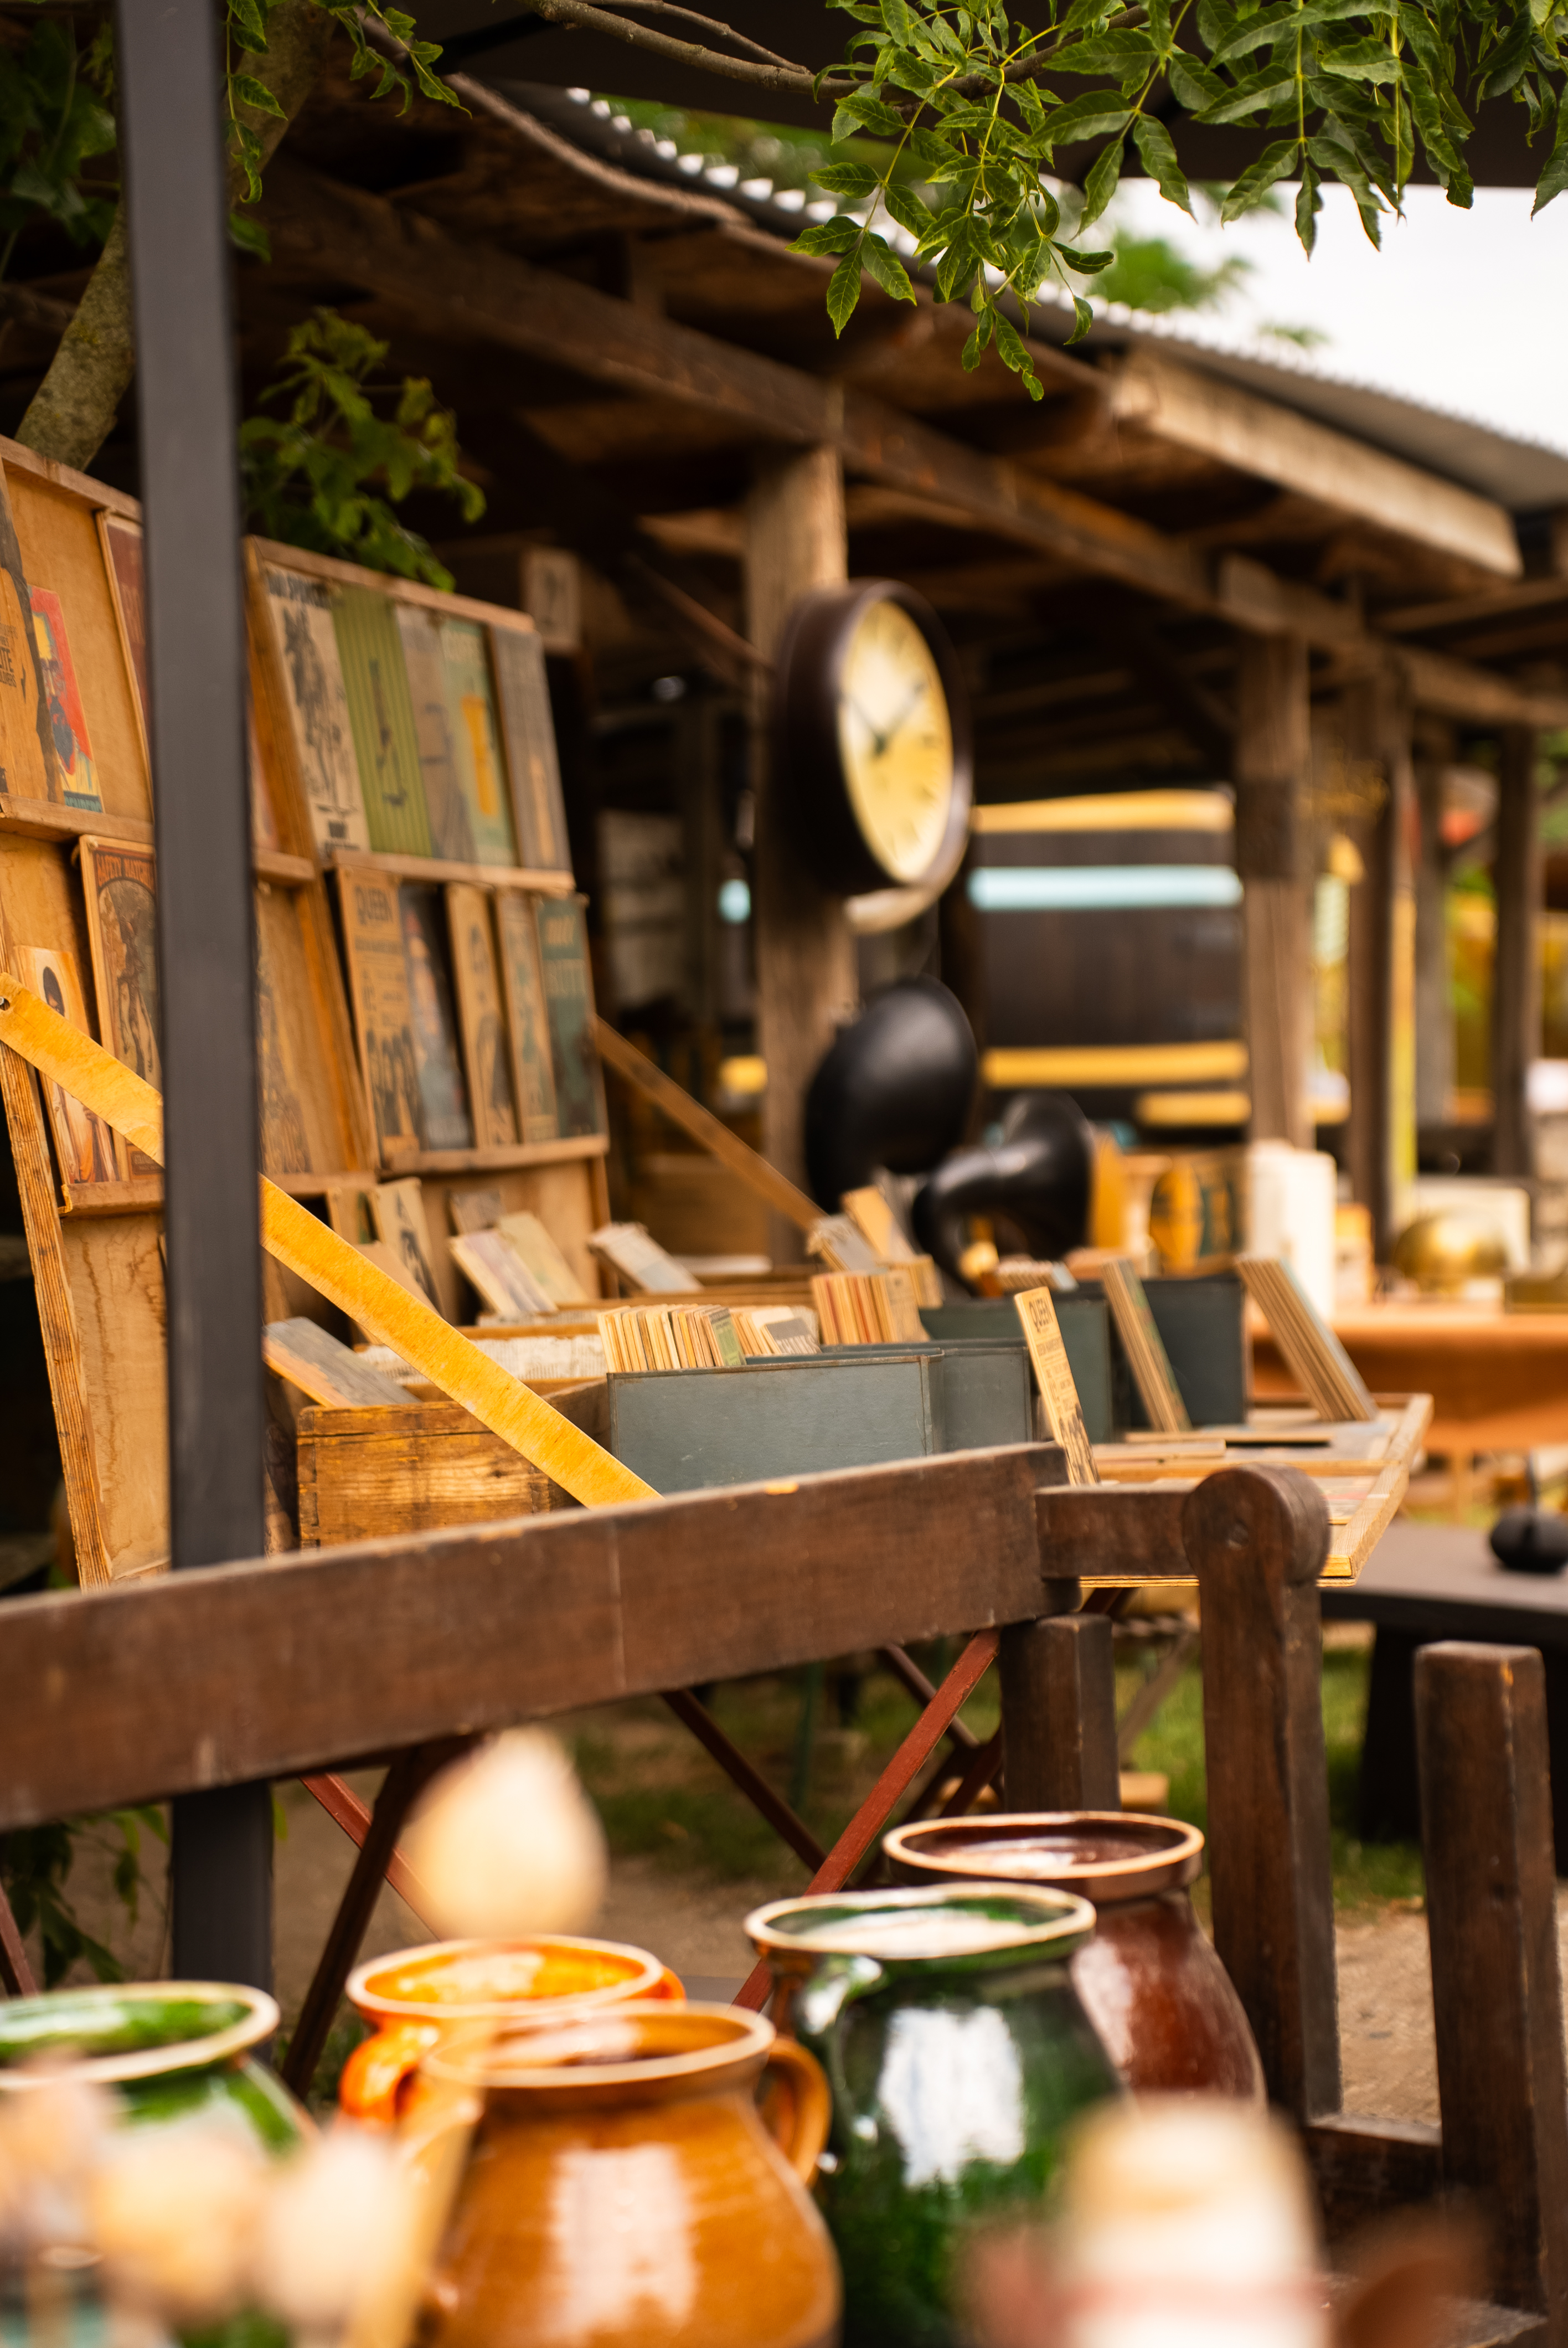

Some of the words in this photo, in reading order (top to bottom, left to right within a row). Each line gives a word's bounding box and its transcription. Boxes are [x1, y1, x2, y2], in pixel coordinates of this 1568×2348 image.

[96, 853, 122, 887] SAFETY
[354, 885, 393, 925] QUEEN
[1029, 1296, 1054, 1334] QUEEN
